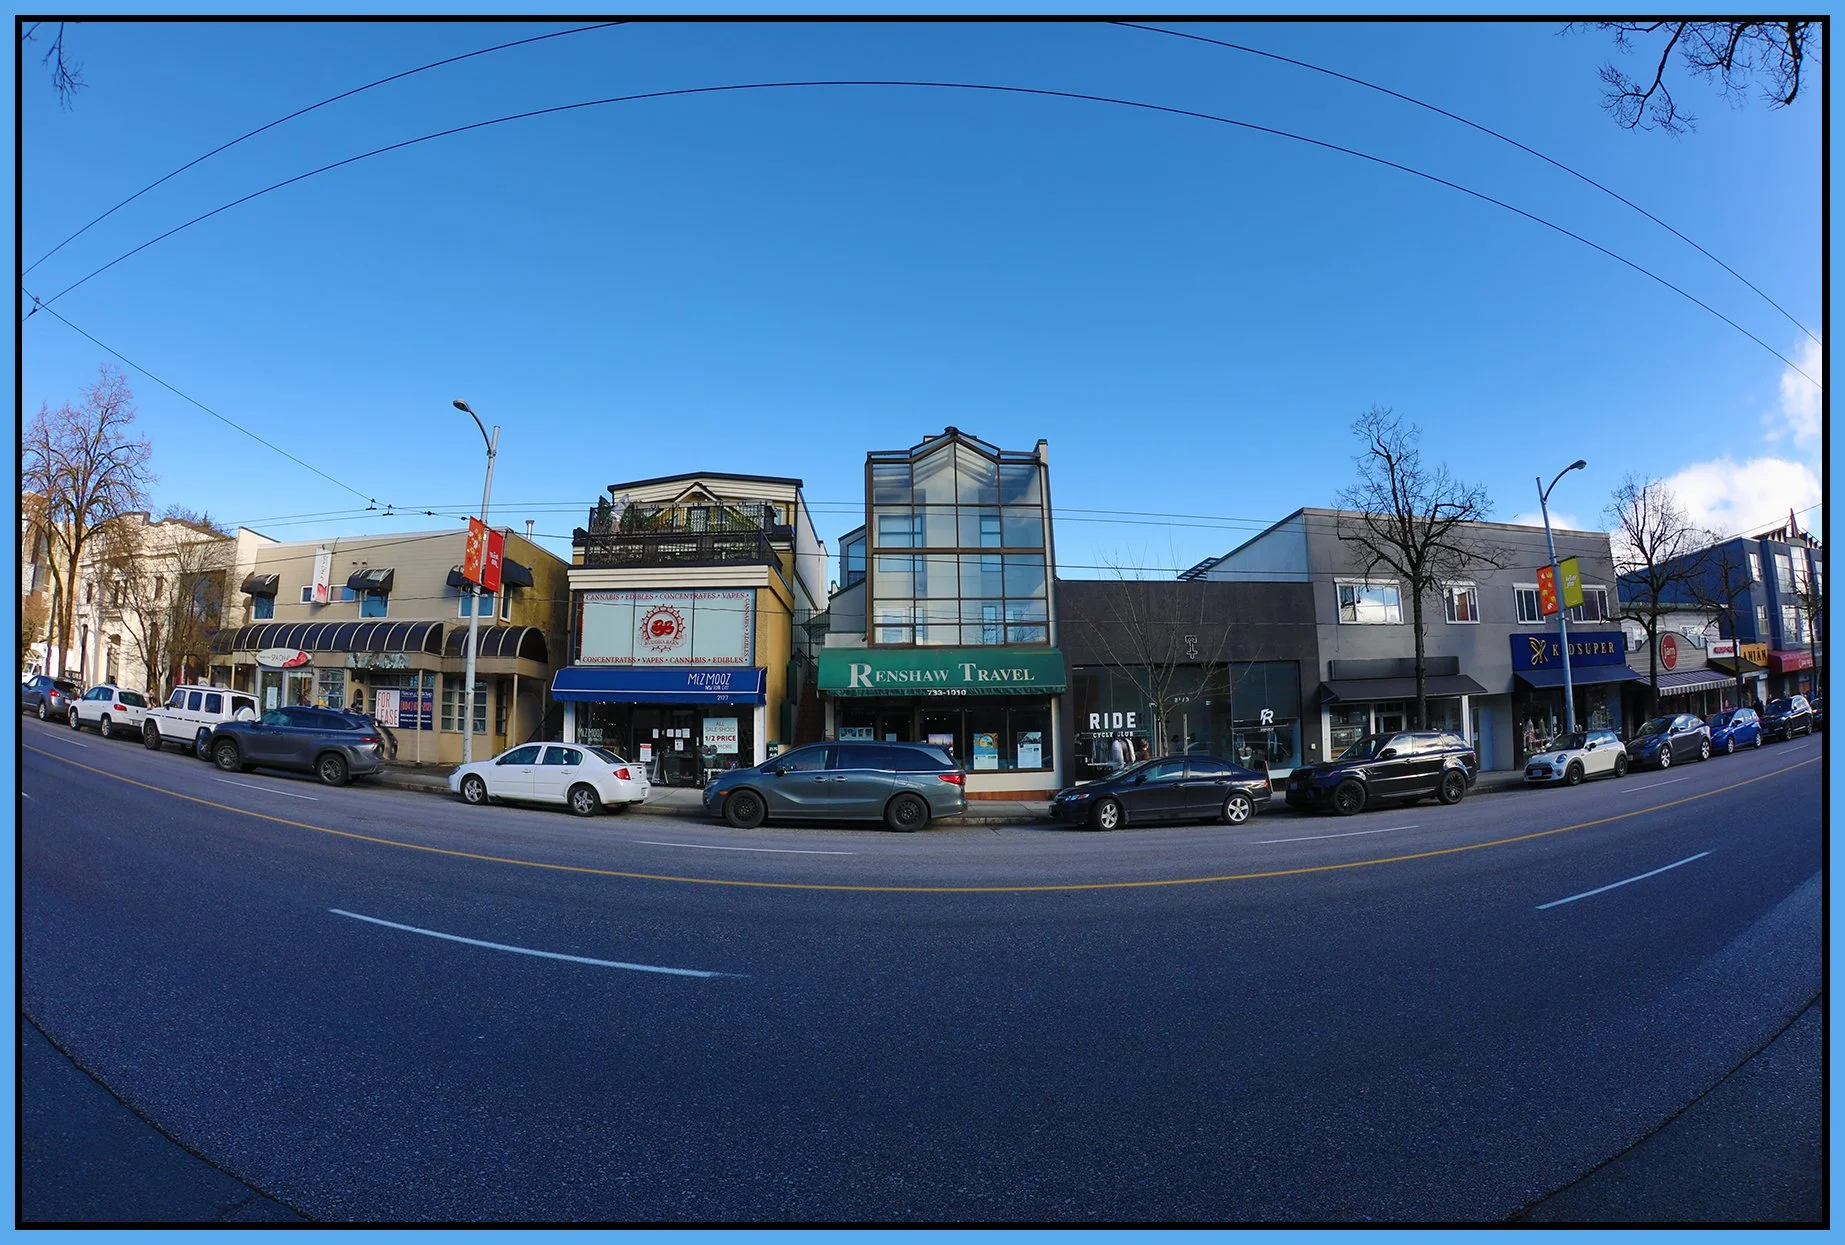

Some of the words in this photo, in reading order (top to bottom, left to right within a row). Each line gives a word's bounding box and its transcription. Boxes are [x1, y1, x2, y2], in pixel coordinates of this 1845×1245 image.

[659, 592, 716, 600] CONCENTRATES
[721, 591, 745, 599] VAPES
[1552, 642, 1615, 656] KDSUPER
[1663, 645, 1676, 659] jam
[582, 656, 637, 664] CONCENTRATES
[642, 656, 664, 664] VAPES
[669, 656, 707, 664] CANNABIS
[712, 656, 744, 664] EDIBLES
[848, 663, 950, 688] RENSHAW
[958, 662, 1035, 682] TRAVEL
[377, 691, 391, 708] FOR
[376, 708, 398, 726] LEASE
[1089, 712, 1137, 730] RIDE
